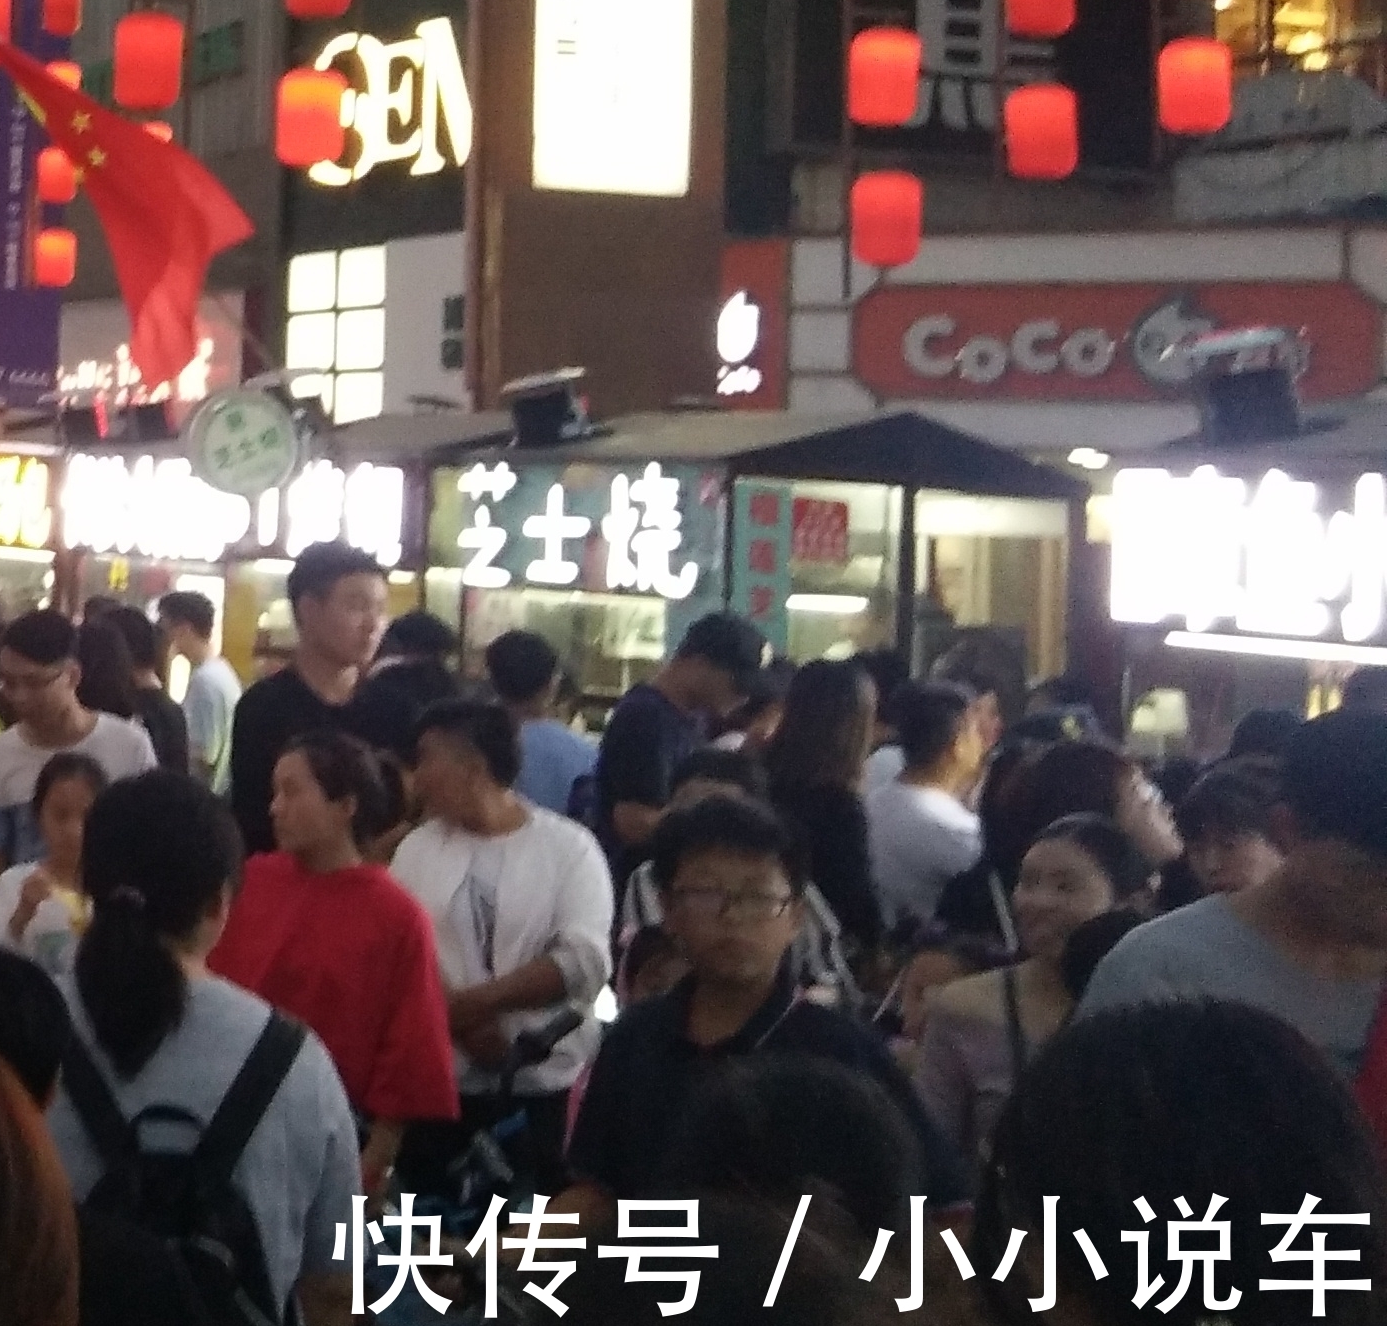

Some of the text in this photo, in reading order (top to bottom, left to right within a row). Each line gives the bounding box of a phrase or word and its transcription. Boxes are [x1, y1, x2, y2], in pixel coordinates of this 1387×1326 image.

[902, 312, 1111, 385] CoCo
[457, 461, 699, 599] 芝士烧
